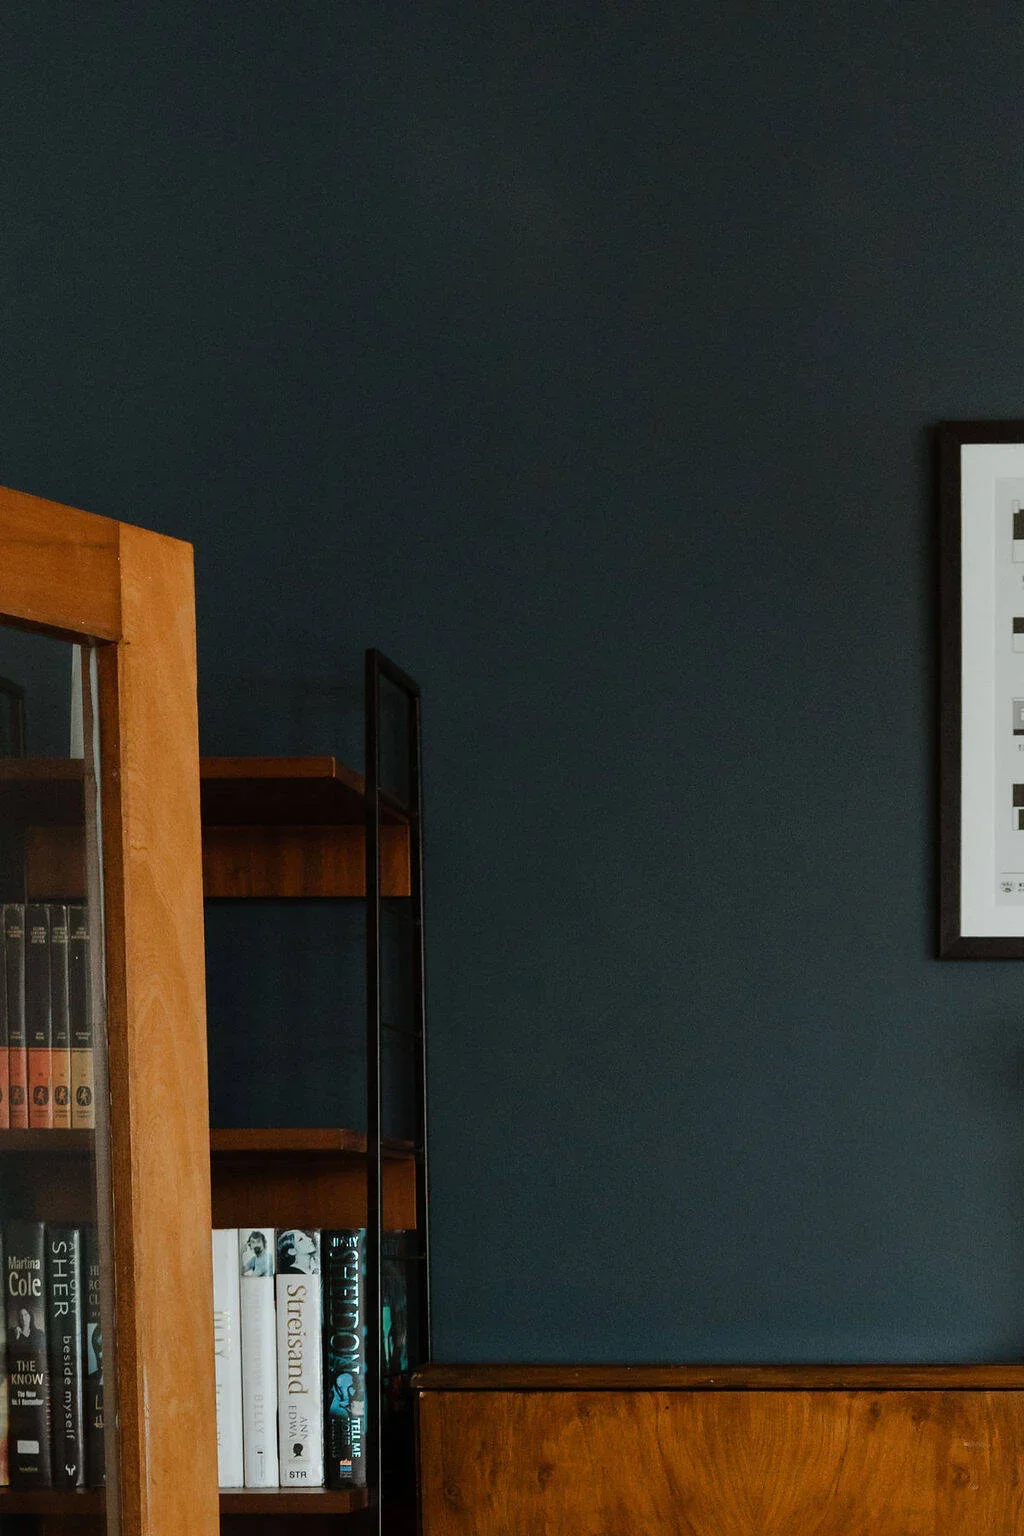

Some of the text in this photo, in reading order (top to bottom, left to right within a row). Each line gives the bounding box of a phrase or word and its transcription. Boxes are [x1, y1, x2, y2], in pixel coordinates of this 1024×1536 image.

[8, 1256, 41, 1270] Martina
[9, 1271, 42, 1296] Cole
[52, 1240, 69, 1319] SHER
[329, 1250, 361, 1375] SHELDON
[286, 1284, 309, 1397] Streisand
[11, 1372, 44, 1385] KNOW
[17, 1360, 37, 1372] THE
[62, 1335, 75, 1440] beside myself
[351, 1418, 361, 1458] TELL ME
[289, 1470, 307, 1479] STR
